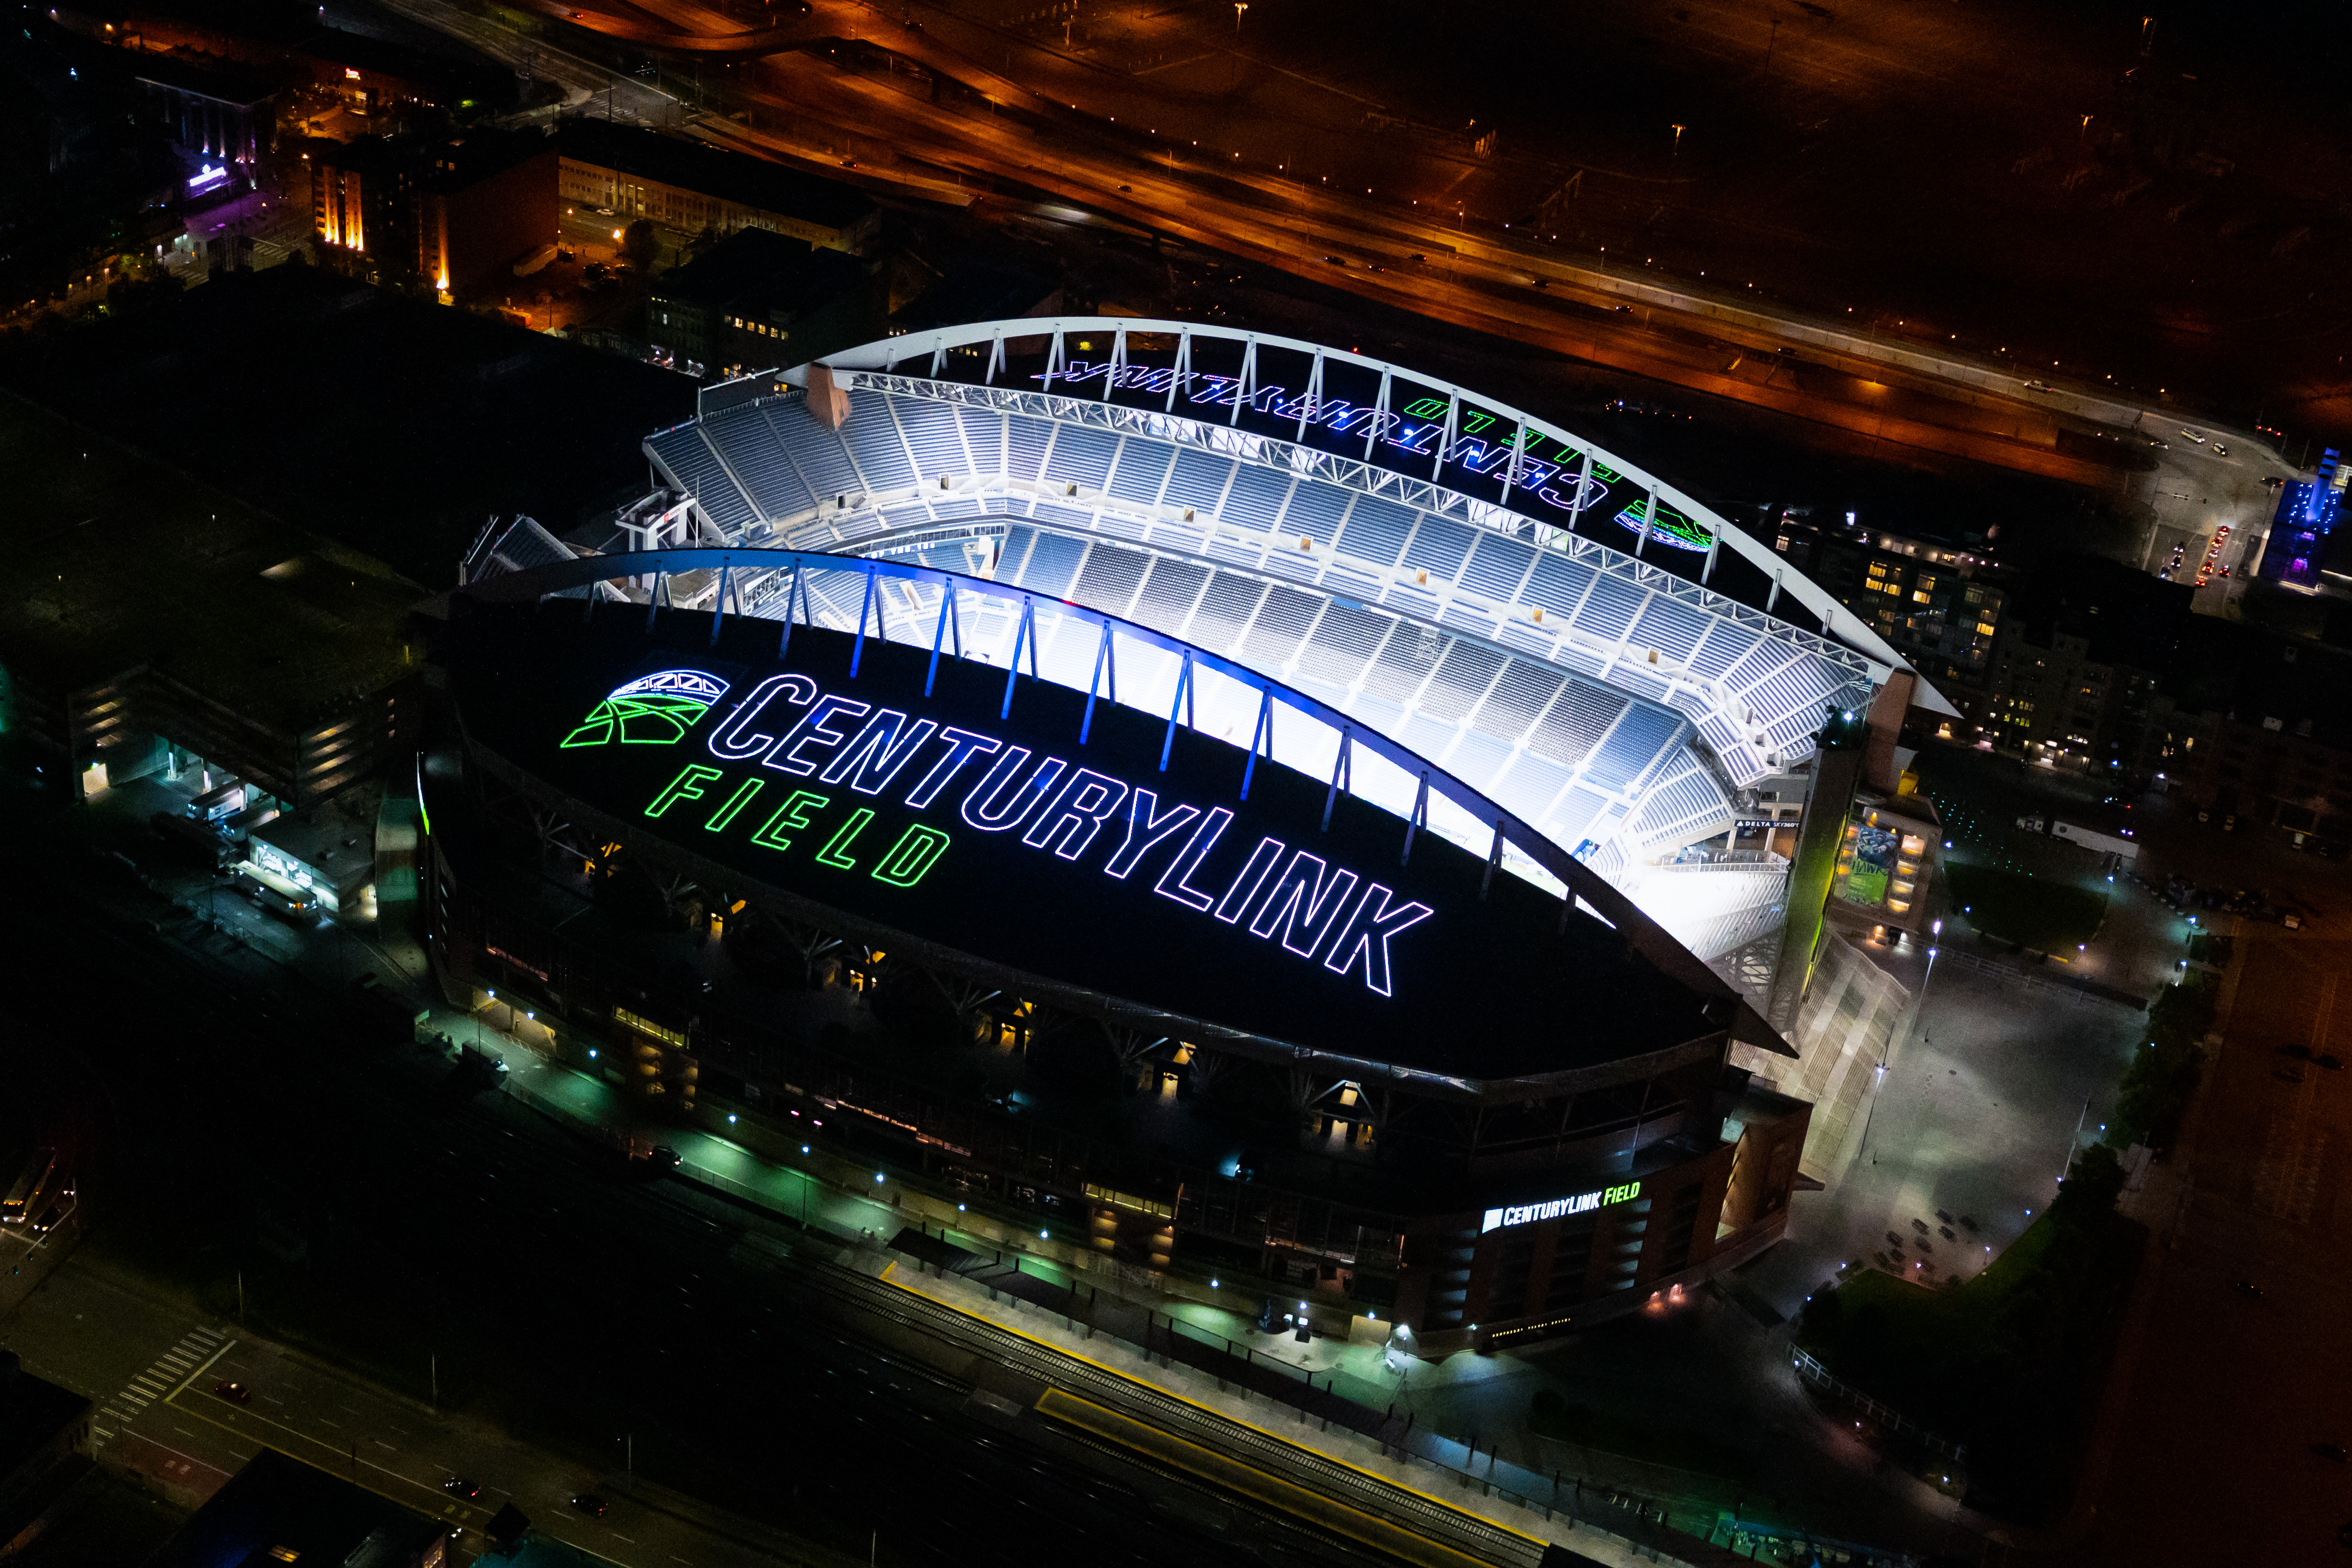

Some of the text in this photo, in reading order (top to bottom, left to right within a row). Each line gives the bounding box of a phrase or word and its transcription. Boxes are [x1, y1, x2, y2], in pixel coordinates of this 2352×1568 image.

[645, 764, 951, 888] FIELD
[708, 674, 1434, 997] CENTURYLINK
[1504, 1181, 1641, 1226] CENTURYLINK FIELD
